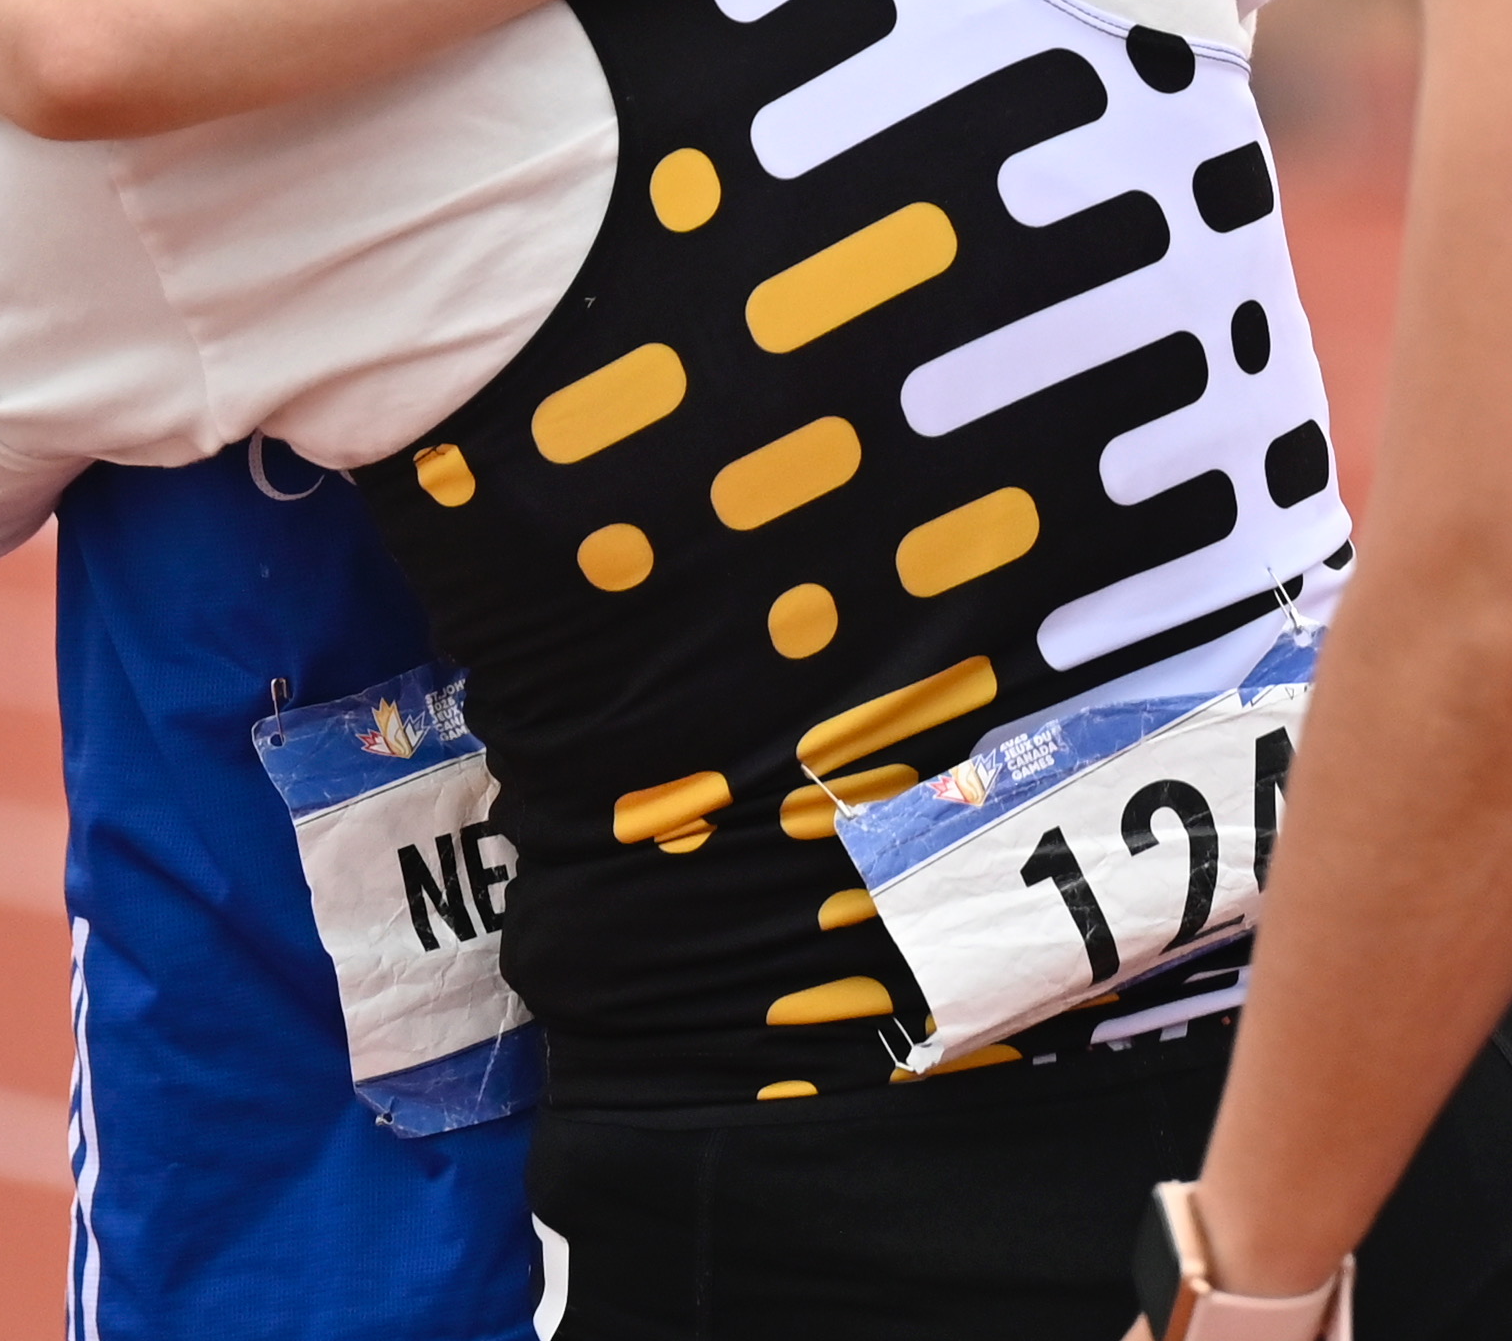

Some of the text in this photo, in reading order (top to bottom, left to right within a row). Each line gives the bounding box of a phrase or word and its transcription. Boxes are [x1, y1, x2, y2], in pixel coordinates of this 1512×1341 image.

[1004, 730, 1053, 762] JEUX DU
[1006, 741, 1059, 771] CANADA
[1011, 755, 1056, 781] GAMES
